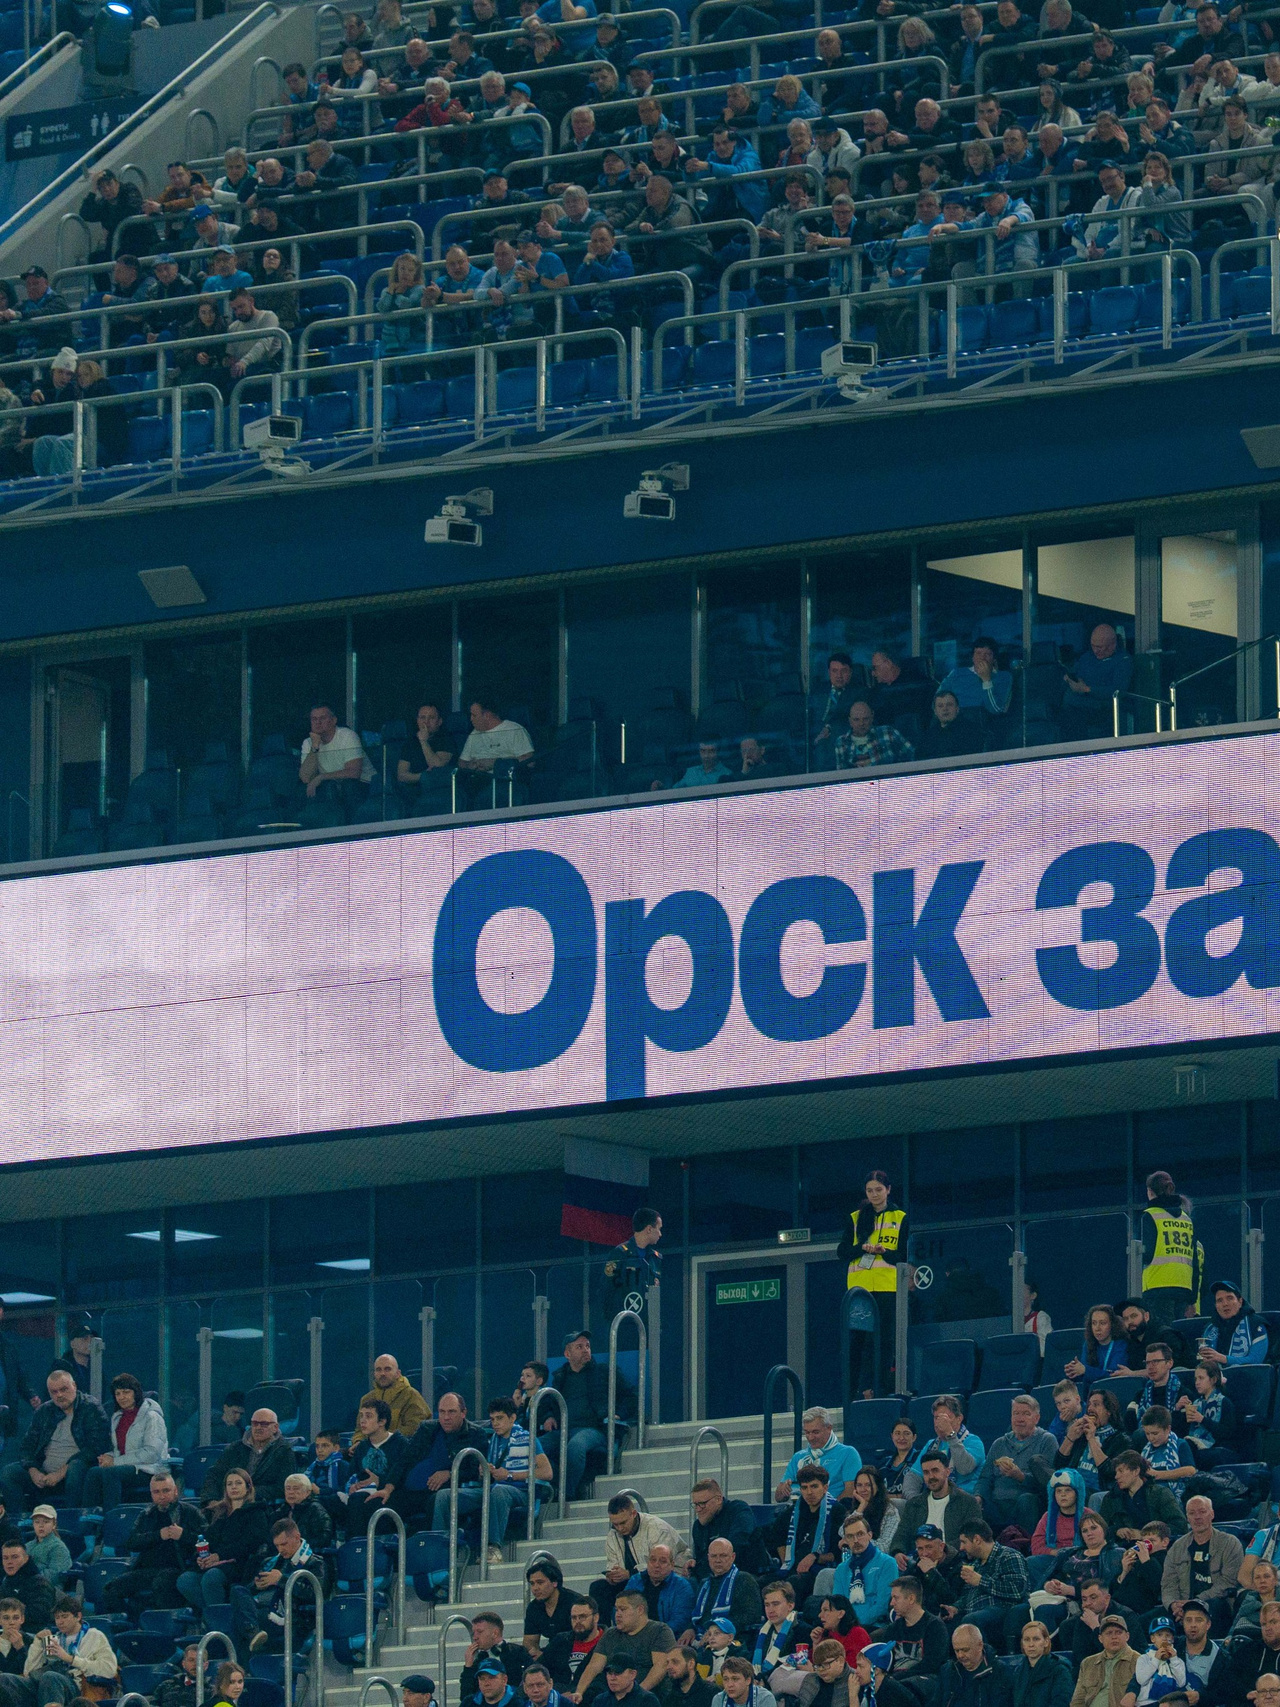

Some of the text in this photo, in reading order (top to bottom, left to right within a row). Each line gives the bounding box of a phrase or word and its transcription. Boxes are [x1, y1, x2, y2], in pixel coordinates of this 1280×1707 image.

[433, 849, 992, 1100] Орск
[780, 1232, 808, 1242] ЫХОД
[718, 1287, 747, 1300] ВЫХОД
